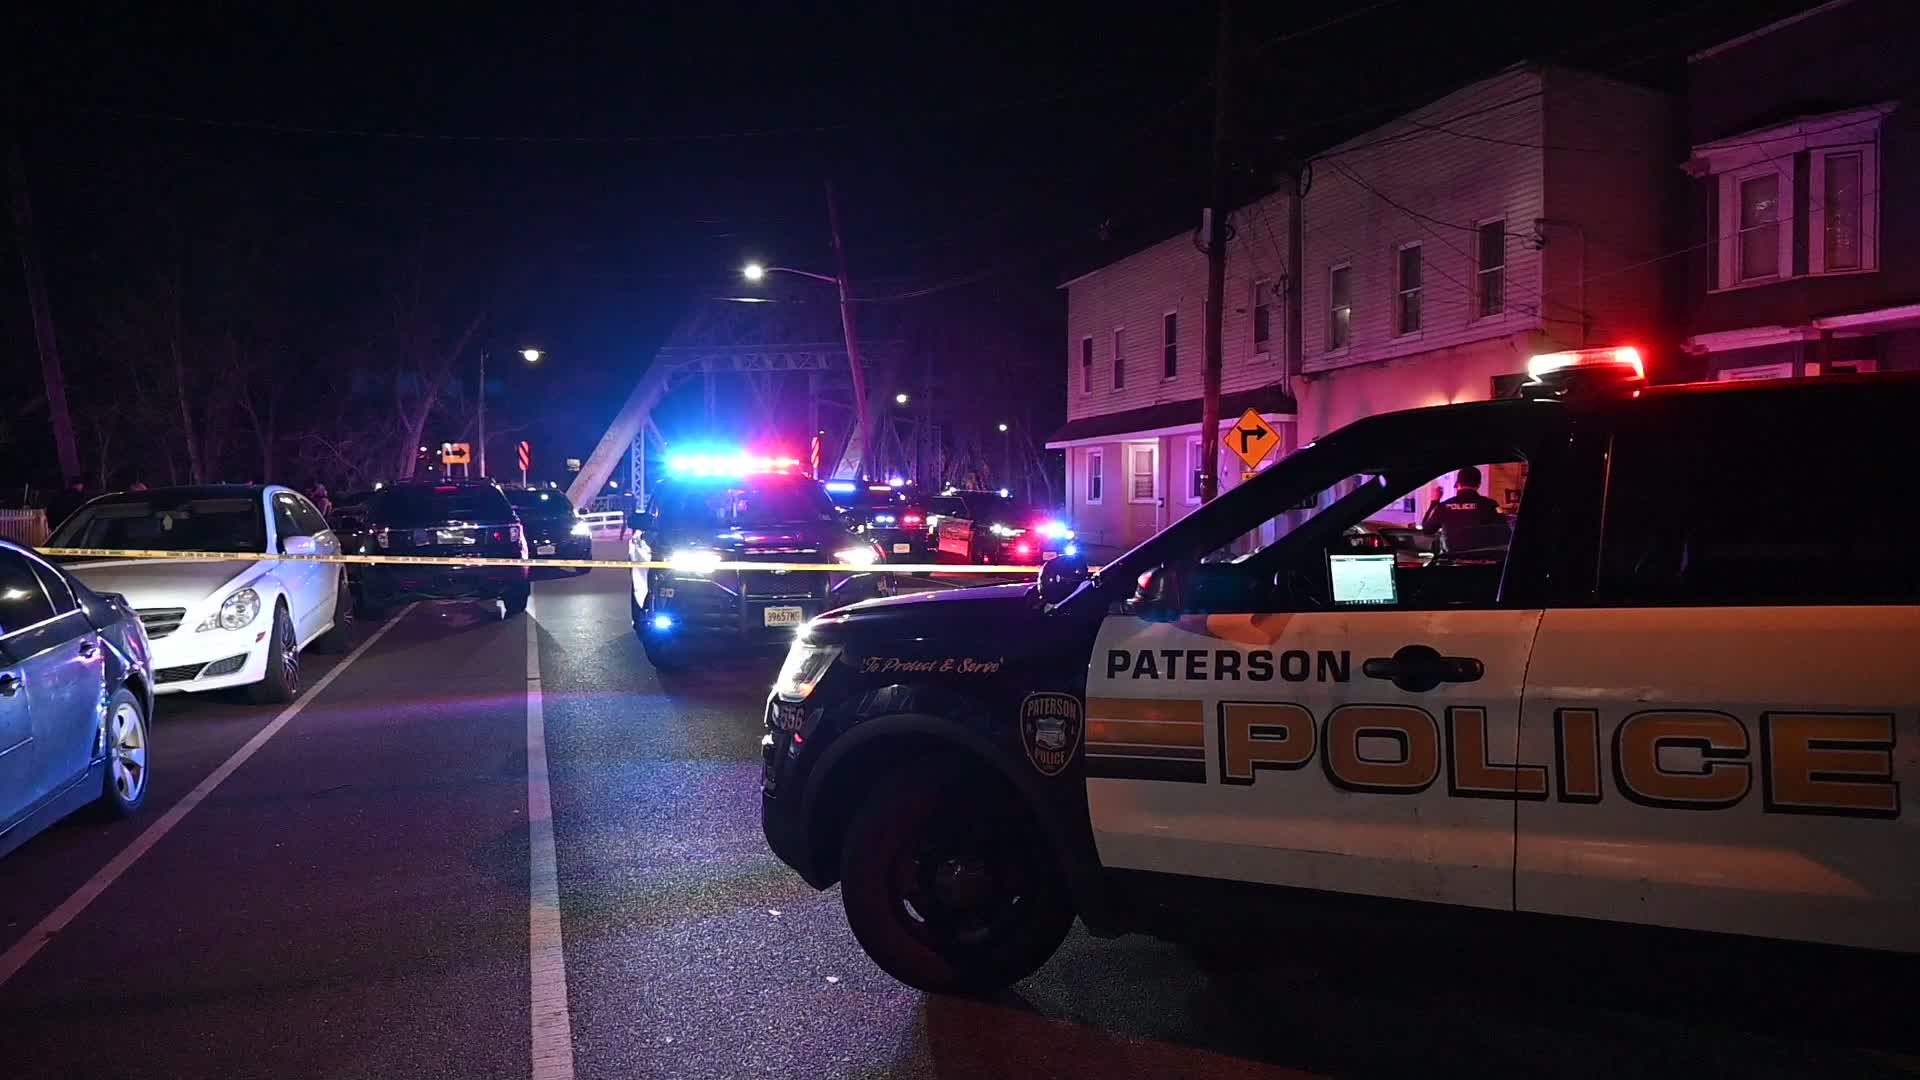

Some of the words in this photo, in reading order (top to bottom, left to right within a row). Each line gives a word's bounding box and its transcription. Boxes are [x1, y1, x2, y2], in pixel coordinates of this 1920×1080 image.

[1445, 502, 1478, 510] POLICE
[881, 657, 937, 673] Protect
[939, 658, 954, 673] &
[1107, 649, 1351, 682] PATERSON
[1026, 698, 1077, 719] PATERSON
[1034, 750, 1066, 765] POLICE
[1217, 701, 1901, 818] POLICE
